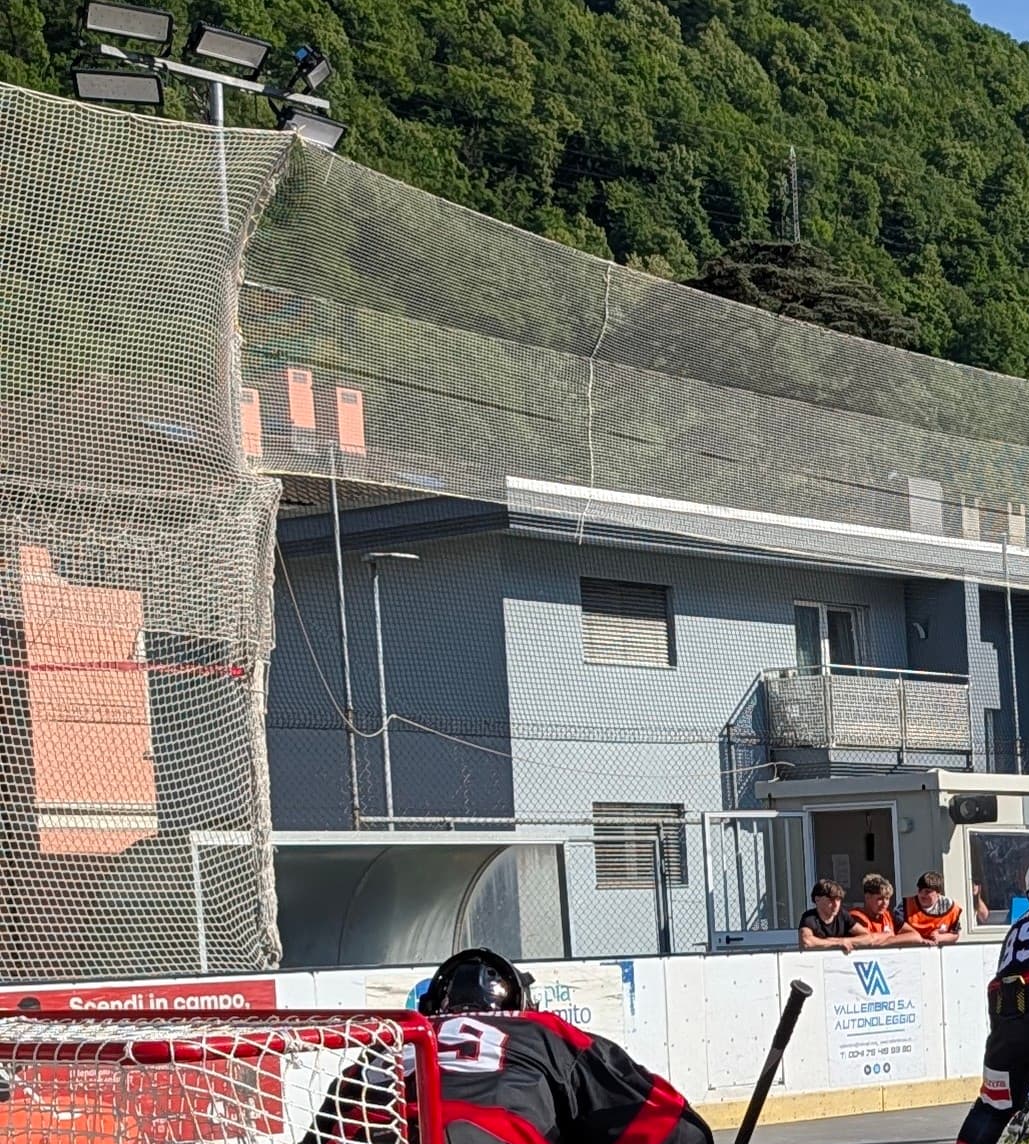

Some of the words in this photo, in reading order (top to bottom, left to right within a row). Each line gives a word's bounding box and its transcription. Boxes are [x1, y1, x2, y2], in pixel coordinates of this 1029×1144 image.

[69, 993, 143, 1010] Scendi
[149, 992, 168, 1009] in
[173, 992, 250, 1010] campo,
[834, 1001, 896, 1015] VALLEMBRO
[834, 1013, 916, 1030] AUTONOLEGGIO
